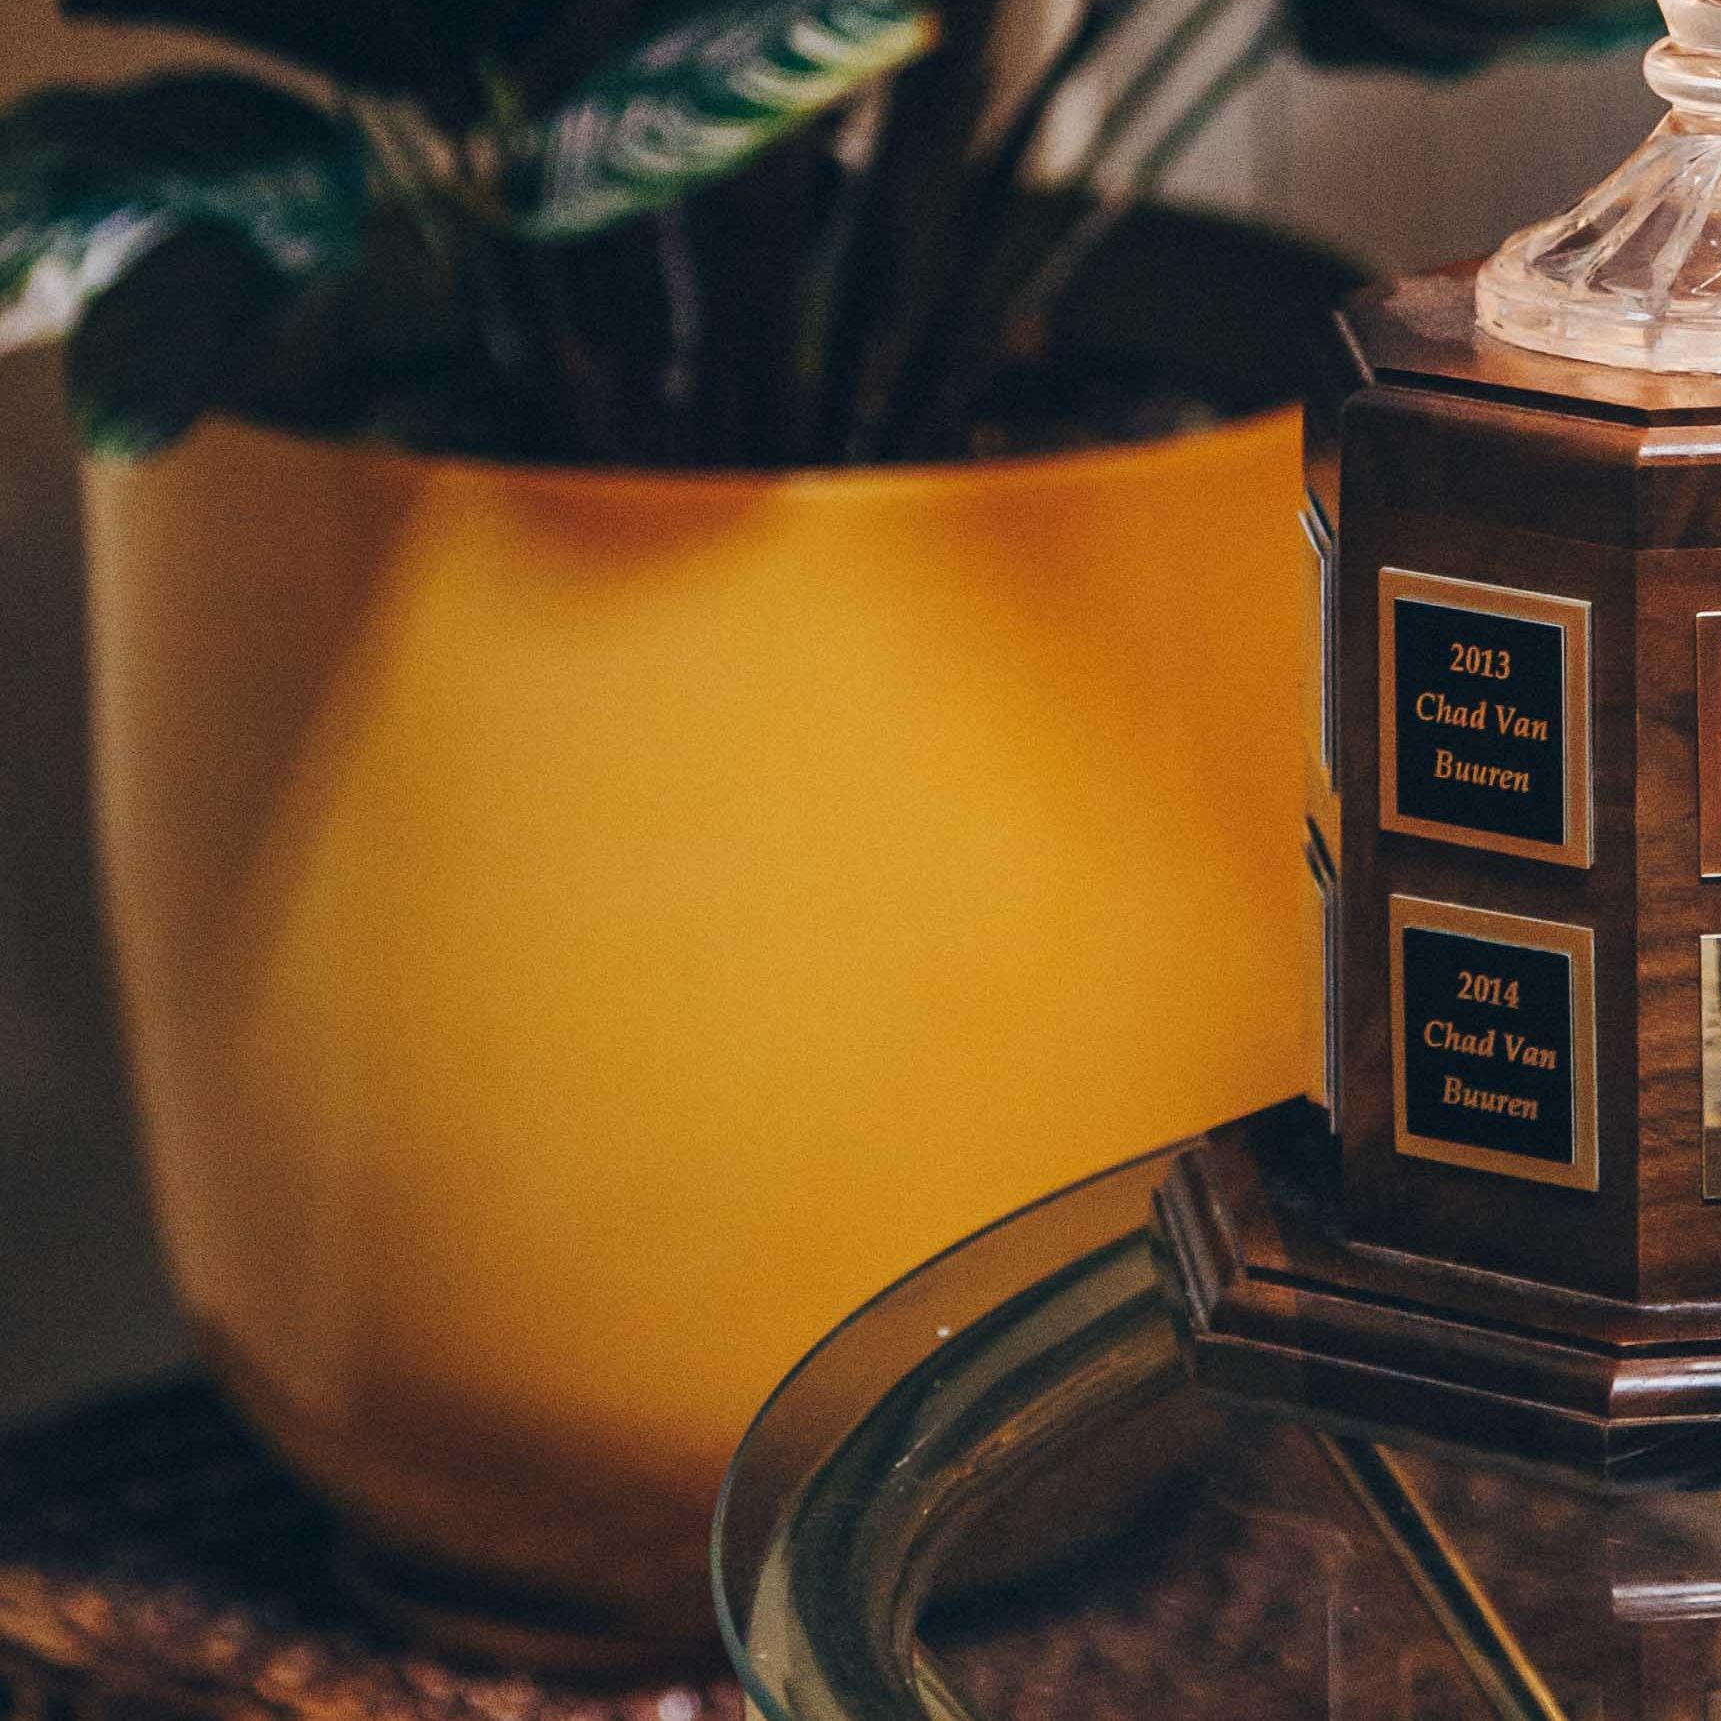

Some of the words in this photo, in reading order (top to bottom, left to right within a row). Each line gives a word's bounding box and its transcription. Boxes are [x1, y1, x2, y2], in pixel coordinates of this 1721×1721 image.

[1450, 642, 1511, 679] 2013
[1416, 691, 1487, 730] Chad
[1495, 703, 1549, 741] Van
[1433, 748, 1530, 793] Buuren
[1456, 970, 1520, 1009] 2014
[1423, 1019, 1496, 1058] Chad
[1504, 1032, 1559, 1070] Van
[1442, 1074, 1538, 1121] Buuren
